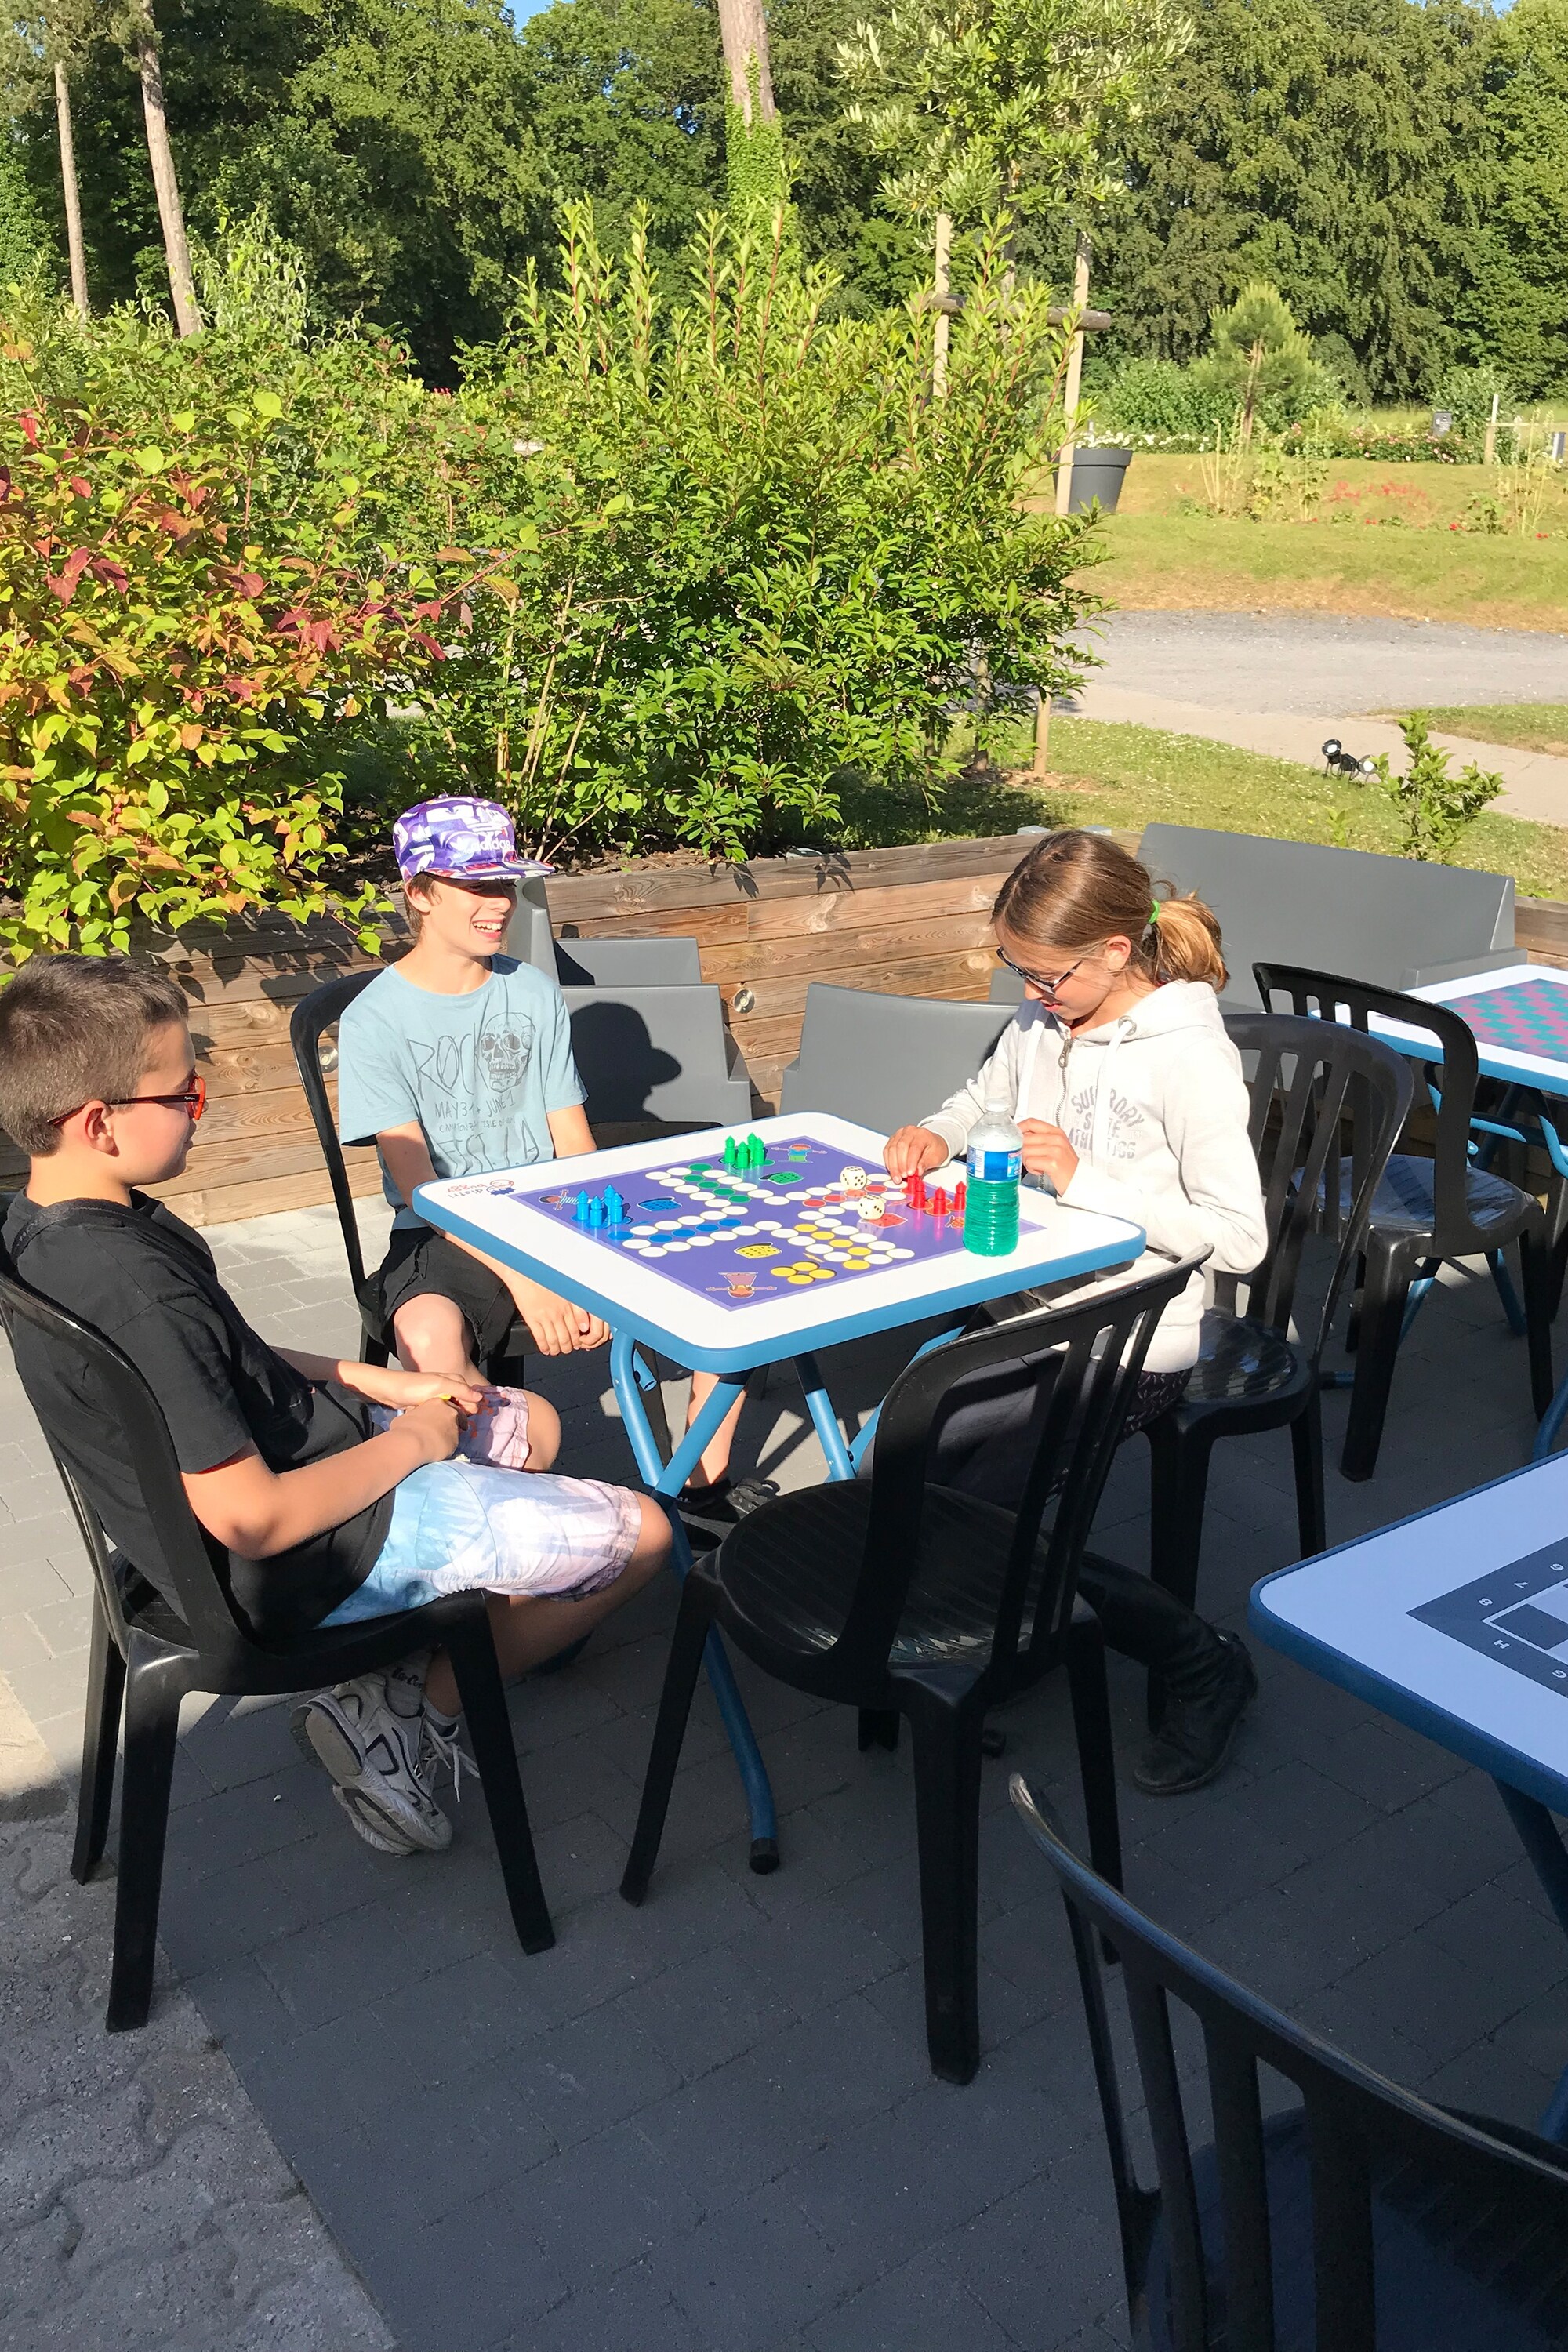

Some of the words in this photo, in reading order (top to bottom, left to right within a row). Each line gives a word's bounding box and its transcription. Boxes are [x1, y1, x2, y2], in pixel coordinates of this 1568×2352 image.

[485, 1094, 507, 1118] JUNE
[1514, 1581, 1529, 1589] 7
[1478, 1598, 1494, 1606] 8
[1493, 1639, 1511, 1650] H
[1552, 1669, 1567, 1679] G
